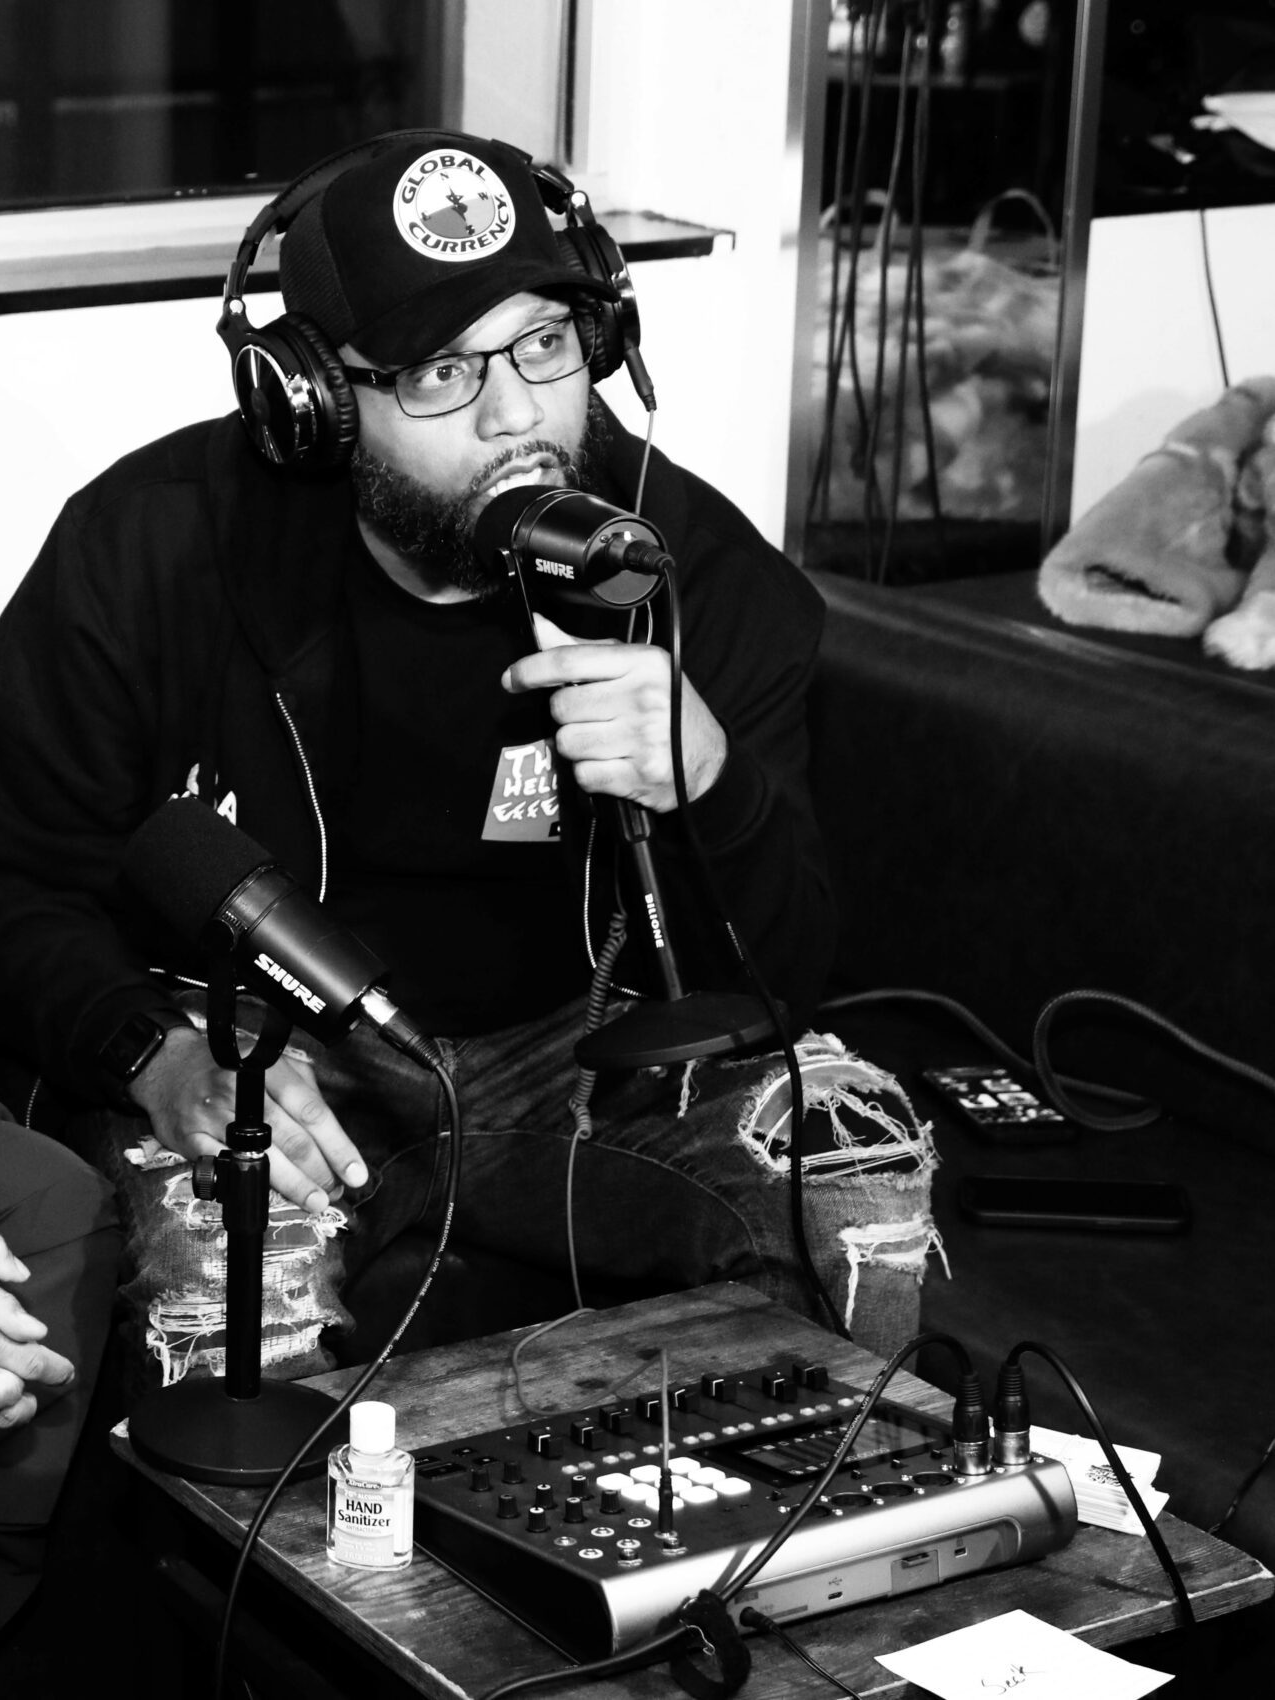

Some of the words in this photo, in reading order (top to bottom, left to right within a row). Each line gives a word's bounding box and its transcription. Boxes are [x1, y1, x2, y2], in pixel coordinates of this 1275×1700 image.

[402, 155, 485, 204] GLOBAL
[409, 195, 509, 253] CURRENCY
[535, 558, 575, 580] SHURE
[504, 745, 552, 778] TH
[493, 796, 559, 823] EFFE
[644, 893, 665, 949] BILIONE
[253, 952, 327, 1014] SHURE
[438, 1202, 455, 1253] PROFESSIONAL
[432, 1257, 441, 1273] LOW
[420, 1276, 433, 1297] NOISE
[394, 1300, 421, 1341] MICROPHONE
[338, 1509, 391, 1527] Sanitizer
[346, 1498, 383, 1515] HAND
